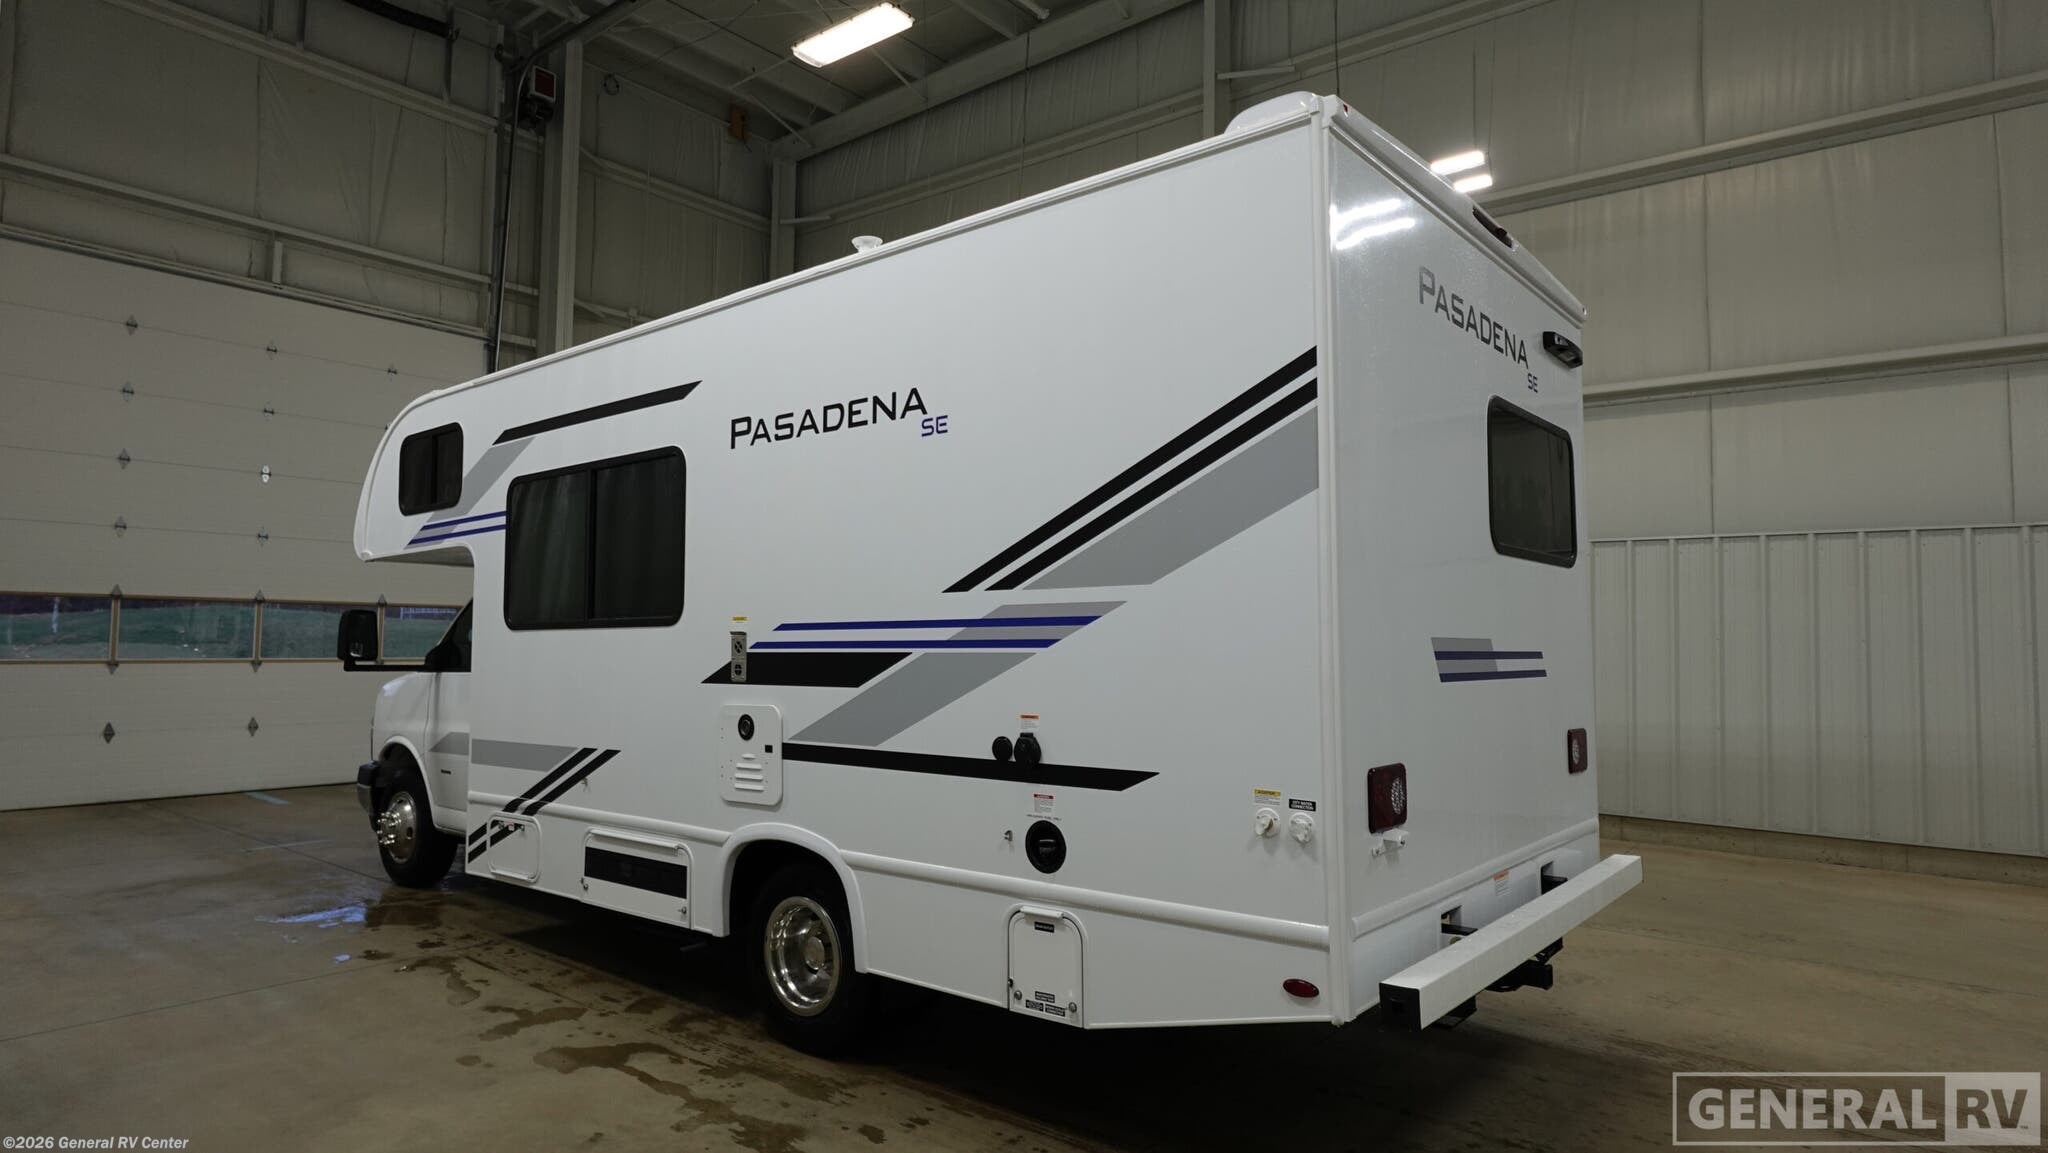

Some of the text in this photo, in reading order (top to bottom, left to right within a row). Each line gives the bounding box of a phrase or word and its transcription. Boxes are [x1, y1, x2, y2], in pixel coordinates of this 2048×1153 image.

[1419, 265, 1538, 393] PASADENA SE
[730, 387, 949, 450] PASADENA SE
